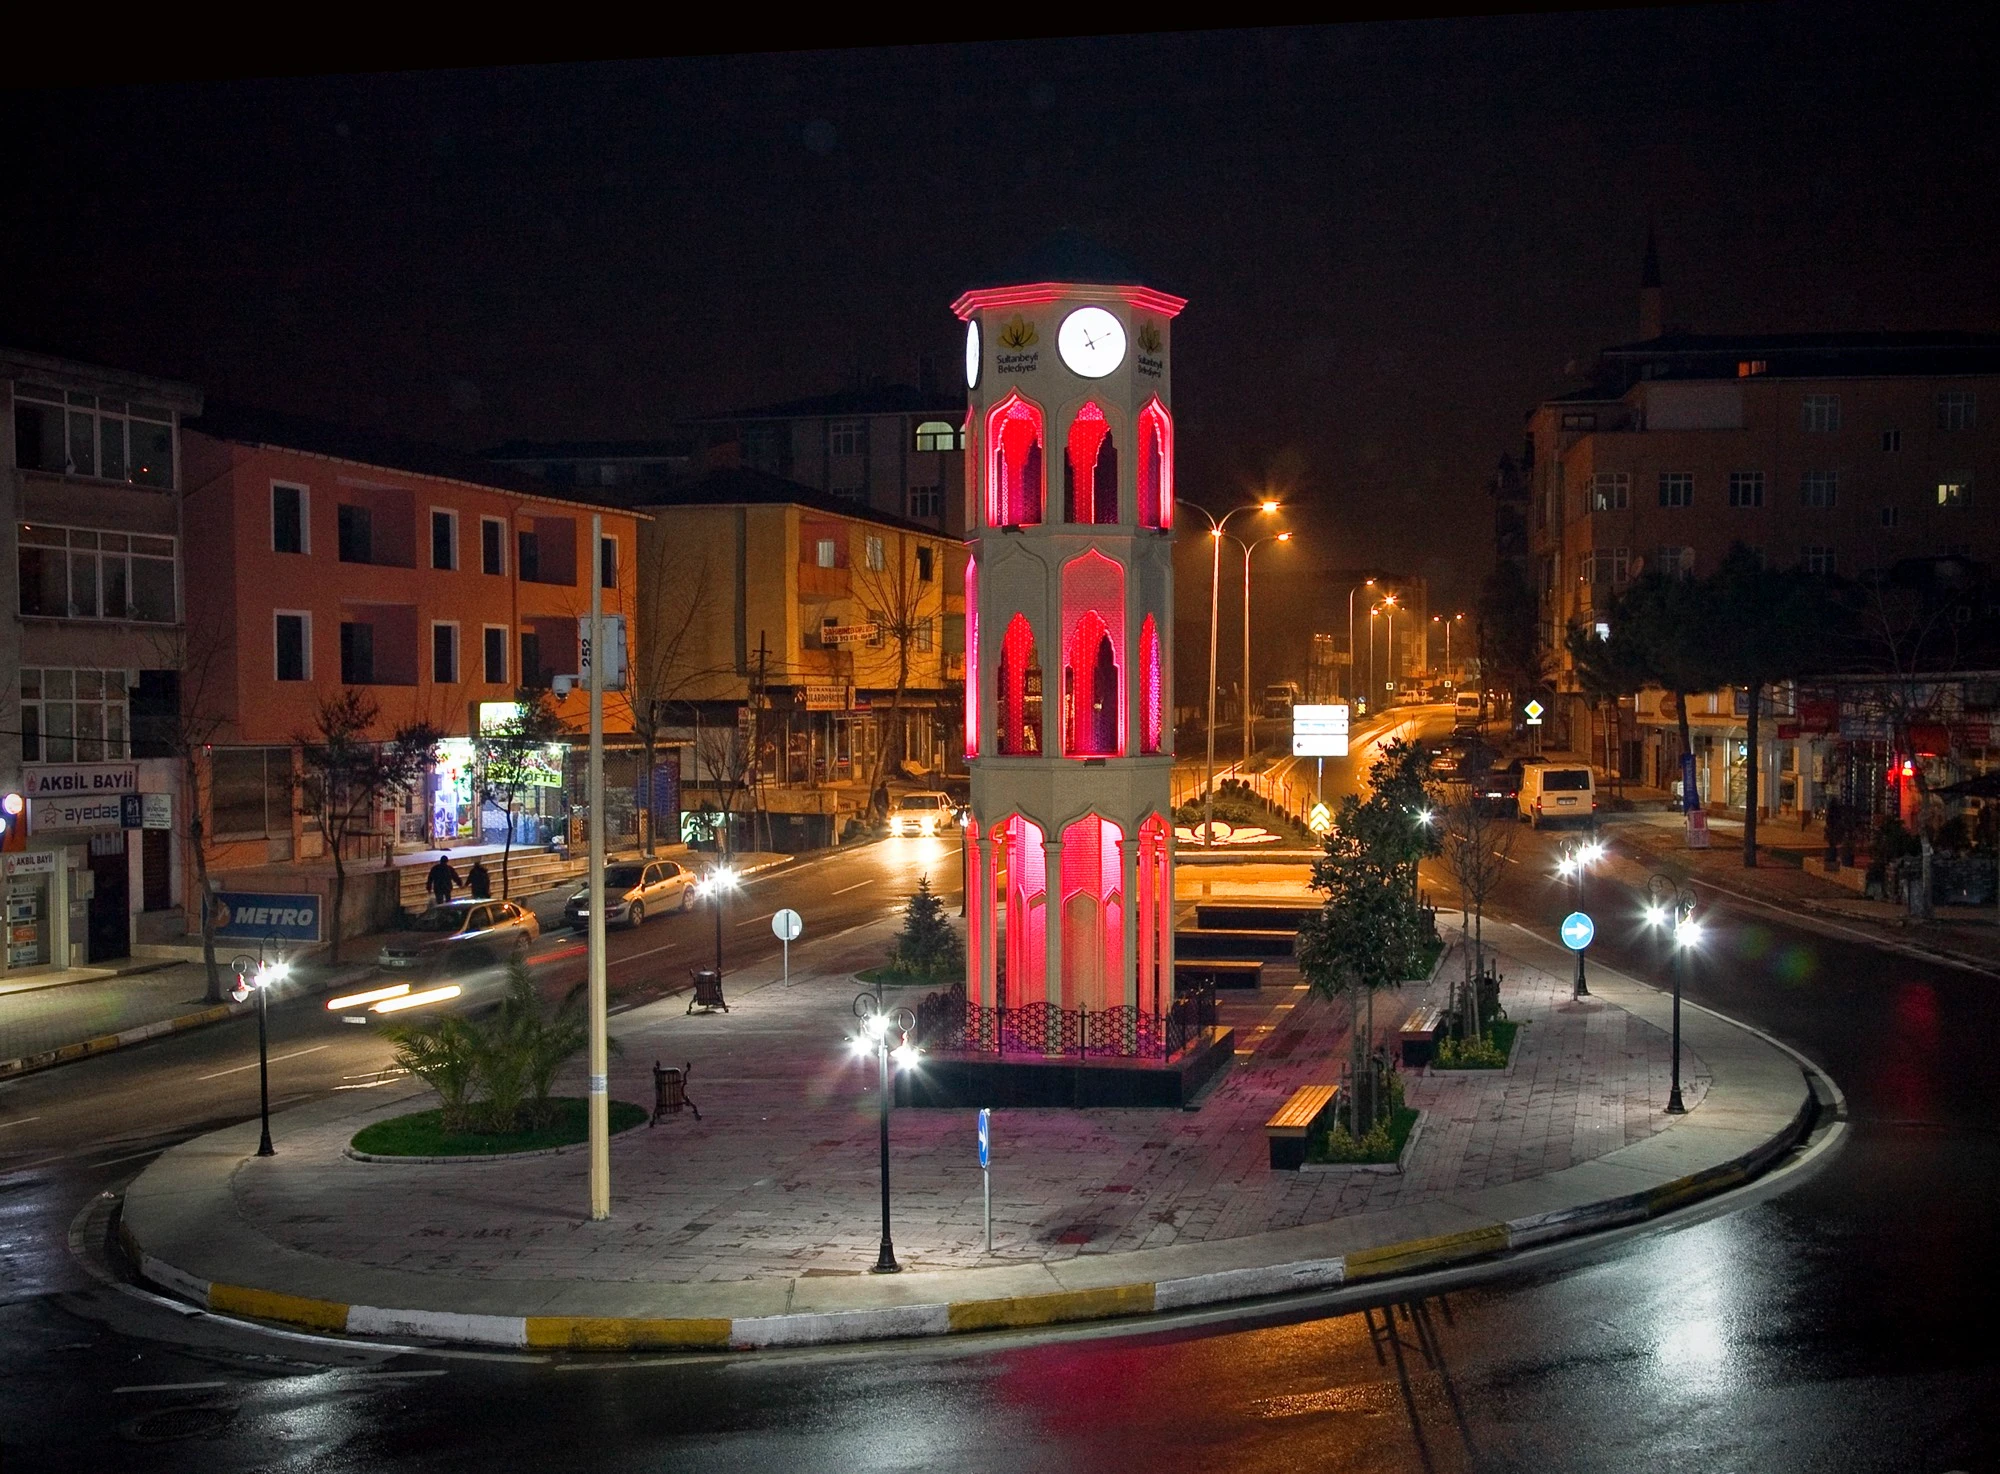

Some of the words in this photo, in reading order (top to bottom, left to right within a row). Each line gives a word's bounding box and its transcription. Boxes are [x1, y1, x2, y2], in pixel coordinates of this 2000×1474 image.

[996, 352, 1039, 364] Sultanbeyli
[998, 363, 1037, 374] Belediyesi
[581, 639, 591, 667] 252
[39, 772, 88, 791] AKBİL
[93, 771, 133, 788] BAYİİ
[64, 804, 119, 824] ayedaş
[16, 855, 36, 866] AKBİL
[36, 853, 53, 865] BAYİİ
[235, 907, 314, 926] METRO
